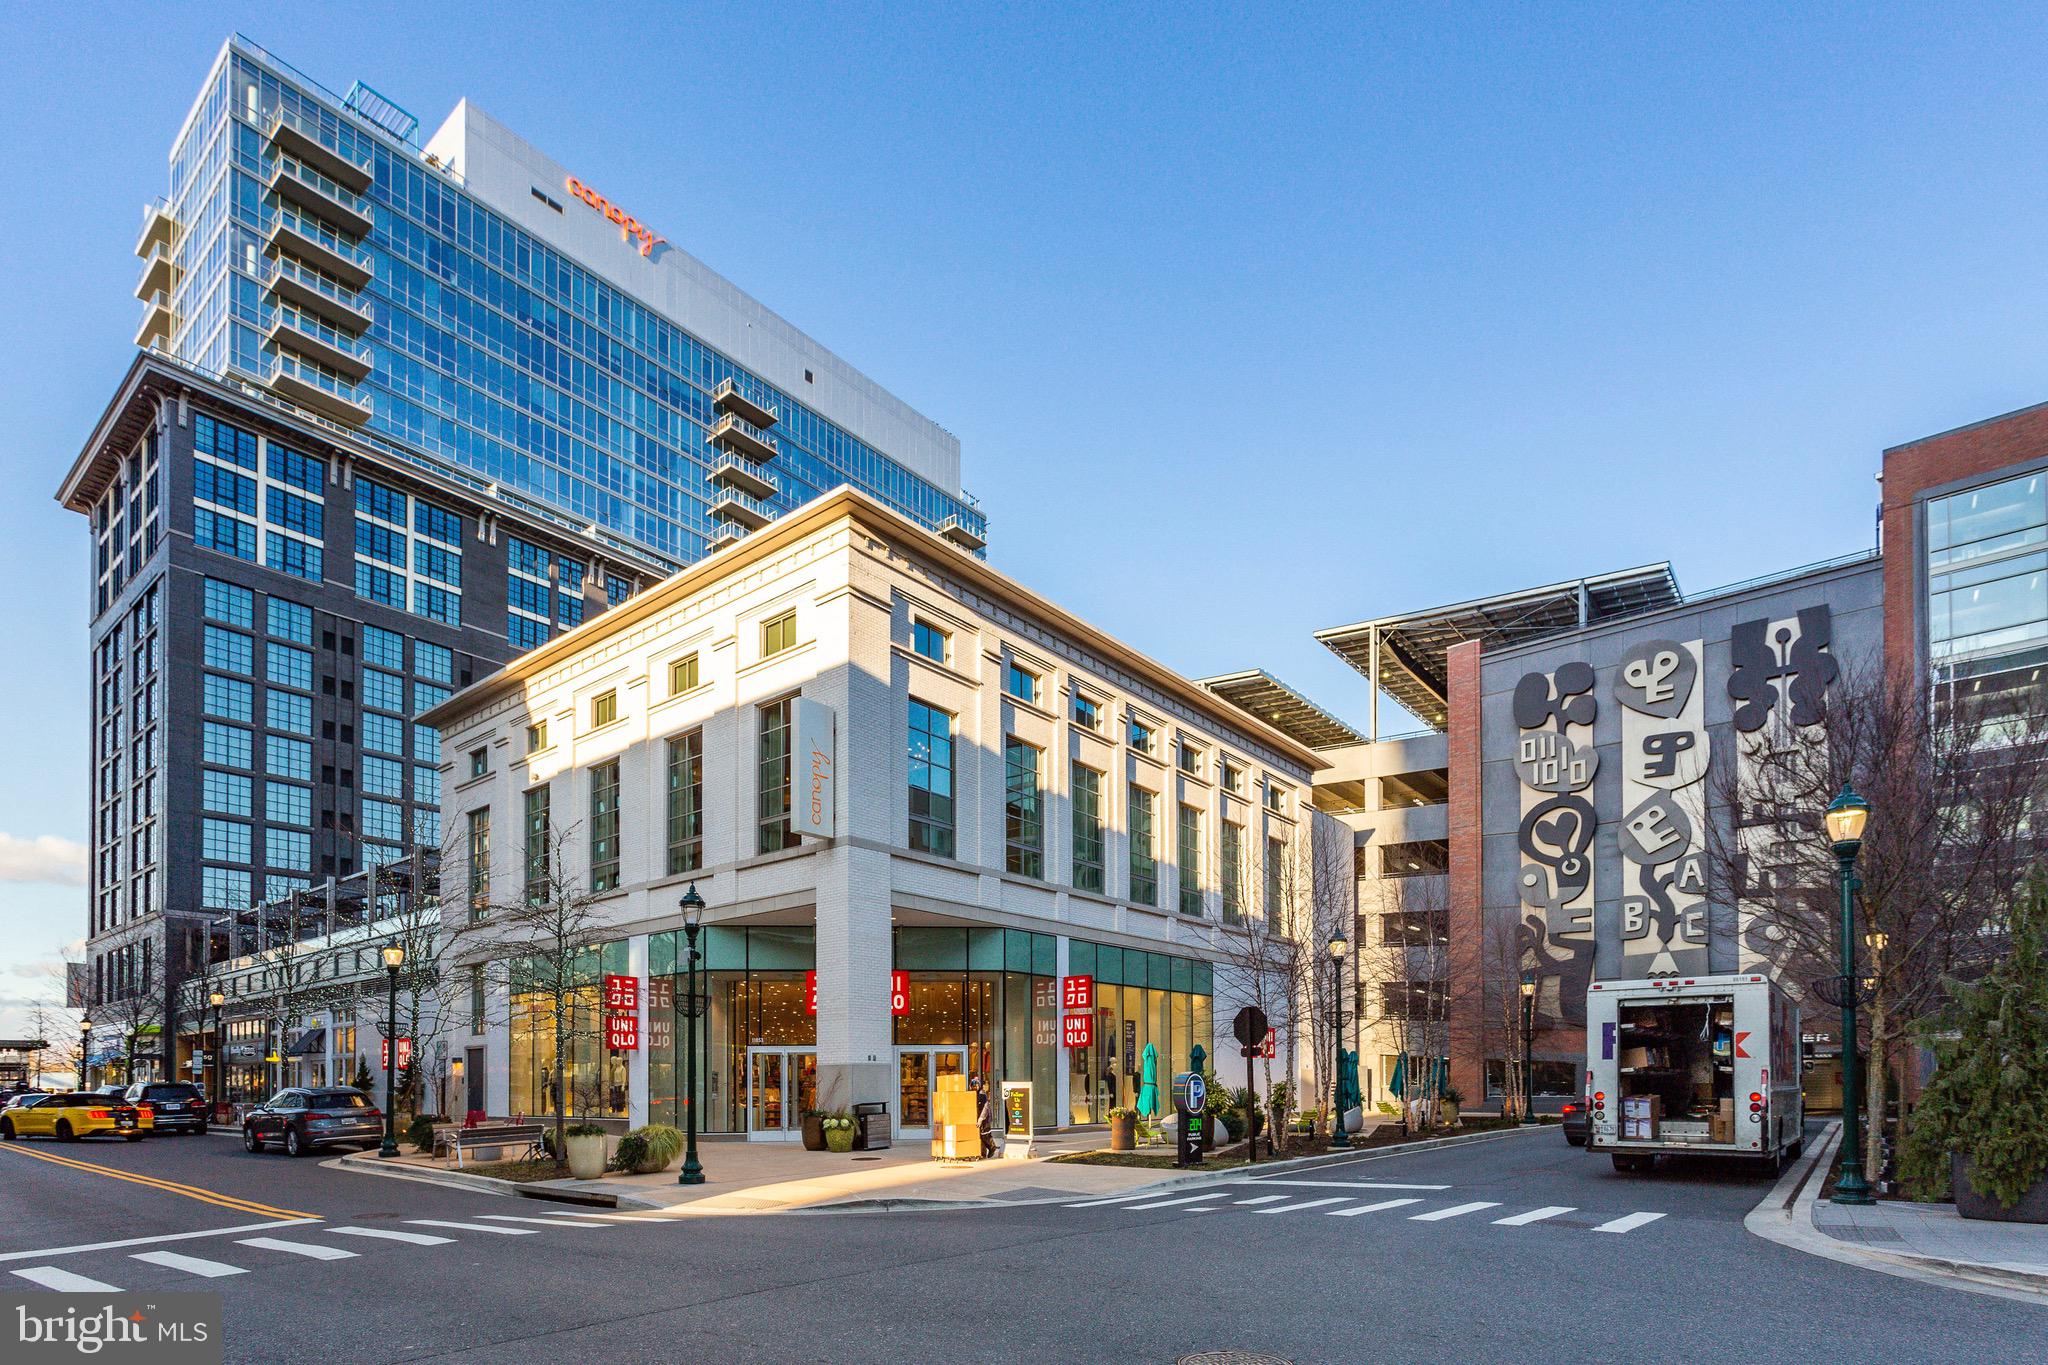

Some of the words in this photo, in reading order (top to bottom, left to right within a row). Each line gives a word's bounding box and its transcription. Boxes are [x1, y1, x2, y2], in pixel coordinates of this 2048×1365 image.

[567, 178, 666, 257] canopy
[811, 737, 831, 825] canopy
[1679, 858, 1704, 888] A
[1624, 902, 1643, 932] B
[612, 1018, 633, 1032] UNI
[1066, 1018, 1086, 1030] UNI
[1066, 1031, 1088, 1045] QLO
[612, 1033, 635, 1047] QLO
[1190, 1080, 1205, 1109] P
